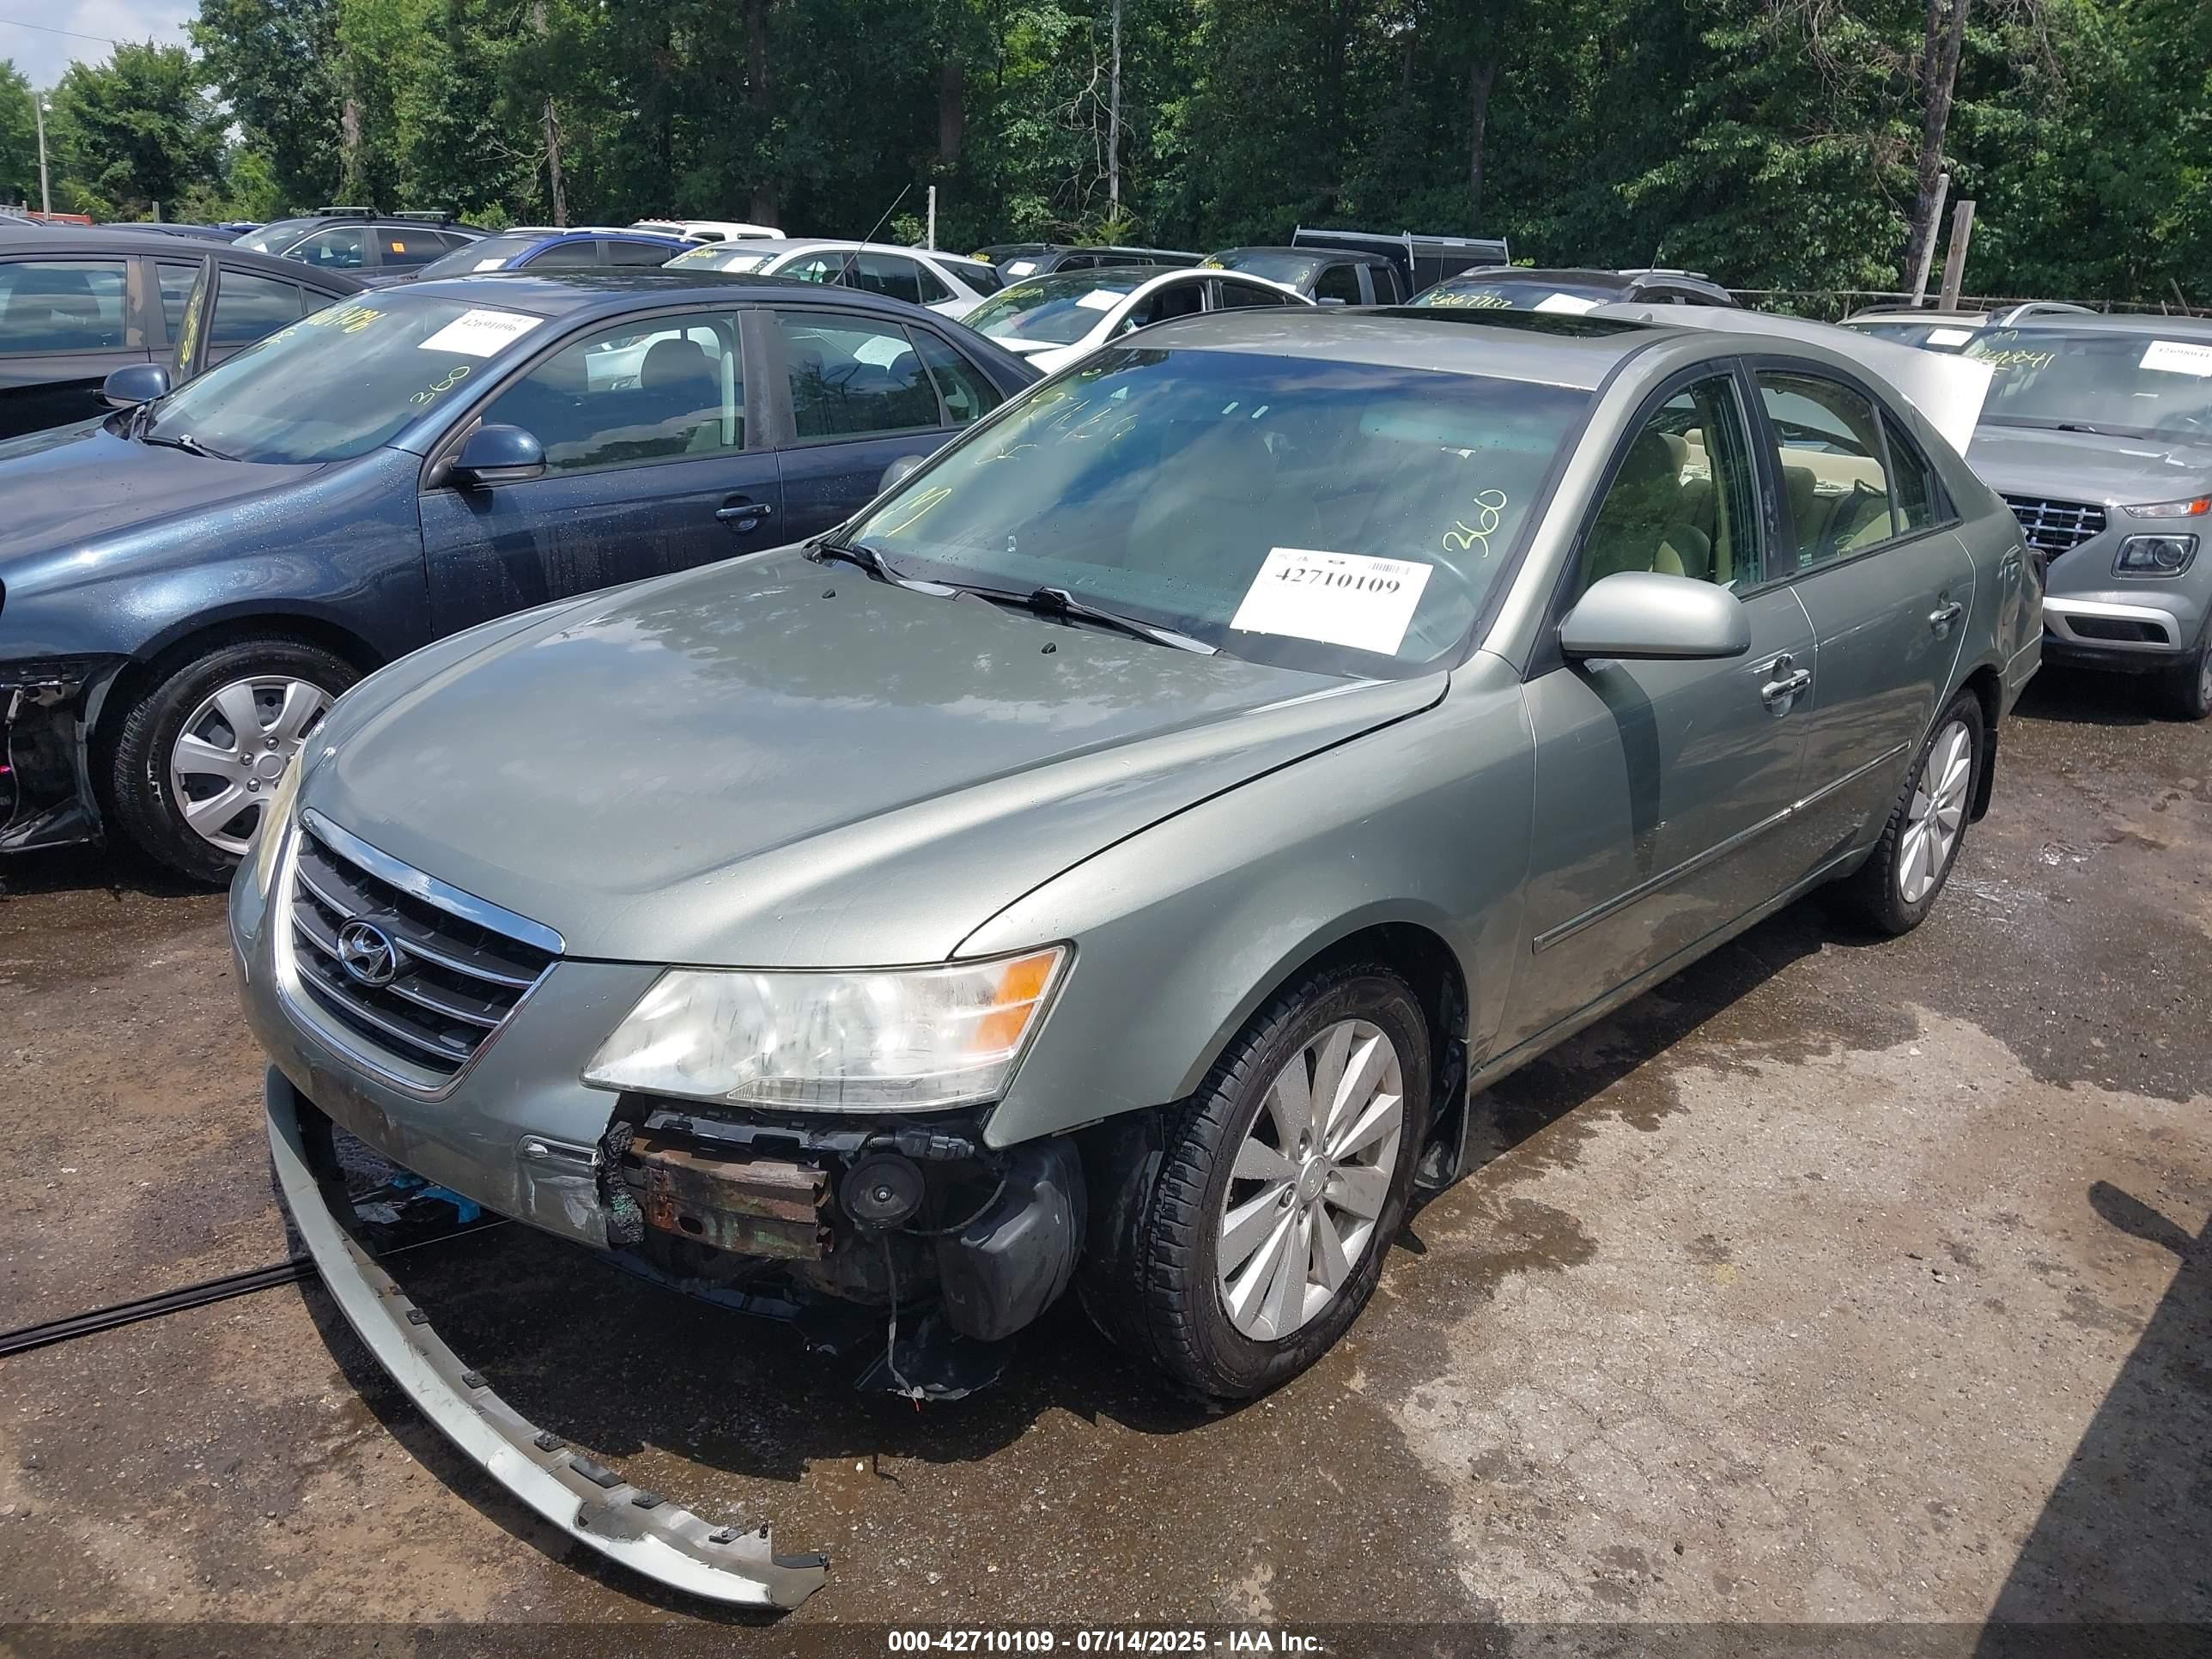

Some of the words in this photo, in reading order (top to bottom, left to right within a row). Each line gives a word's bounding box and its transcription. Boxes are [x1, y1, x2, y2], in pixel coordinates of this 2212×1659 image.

[409, 365, 471, 406] 360
[1442, 489, 1508, 558] 360
[1275, 567, 1401, 594] 42710109
